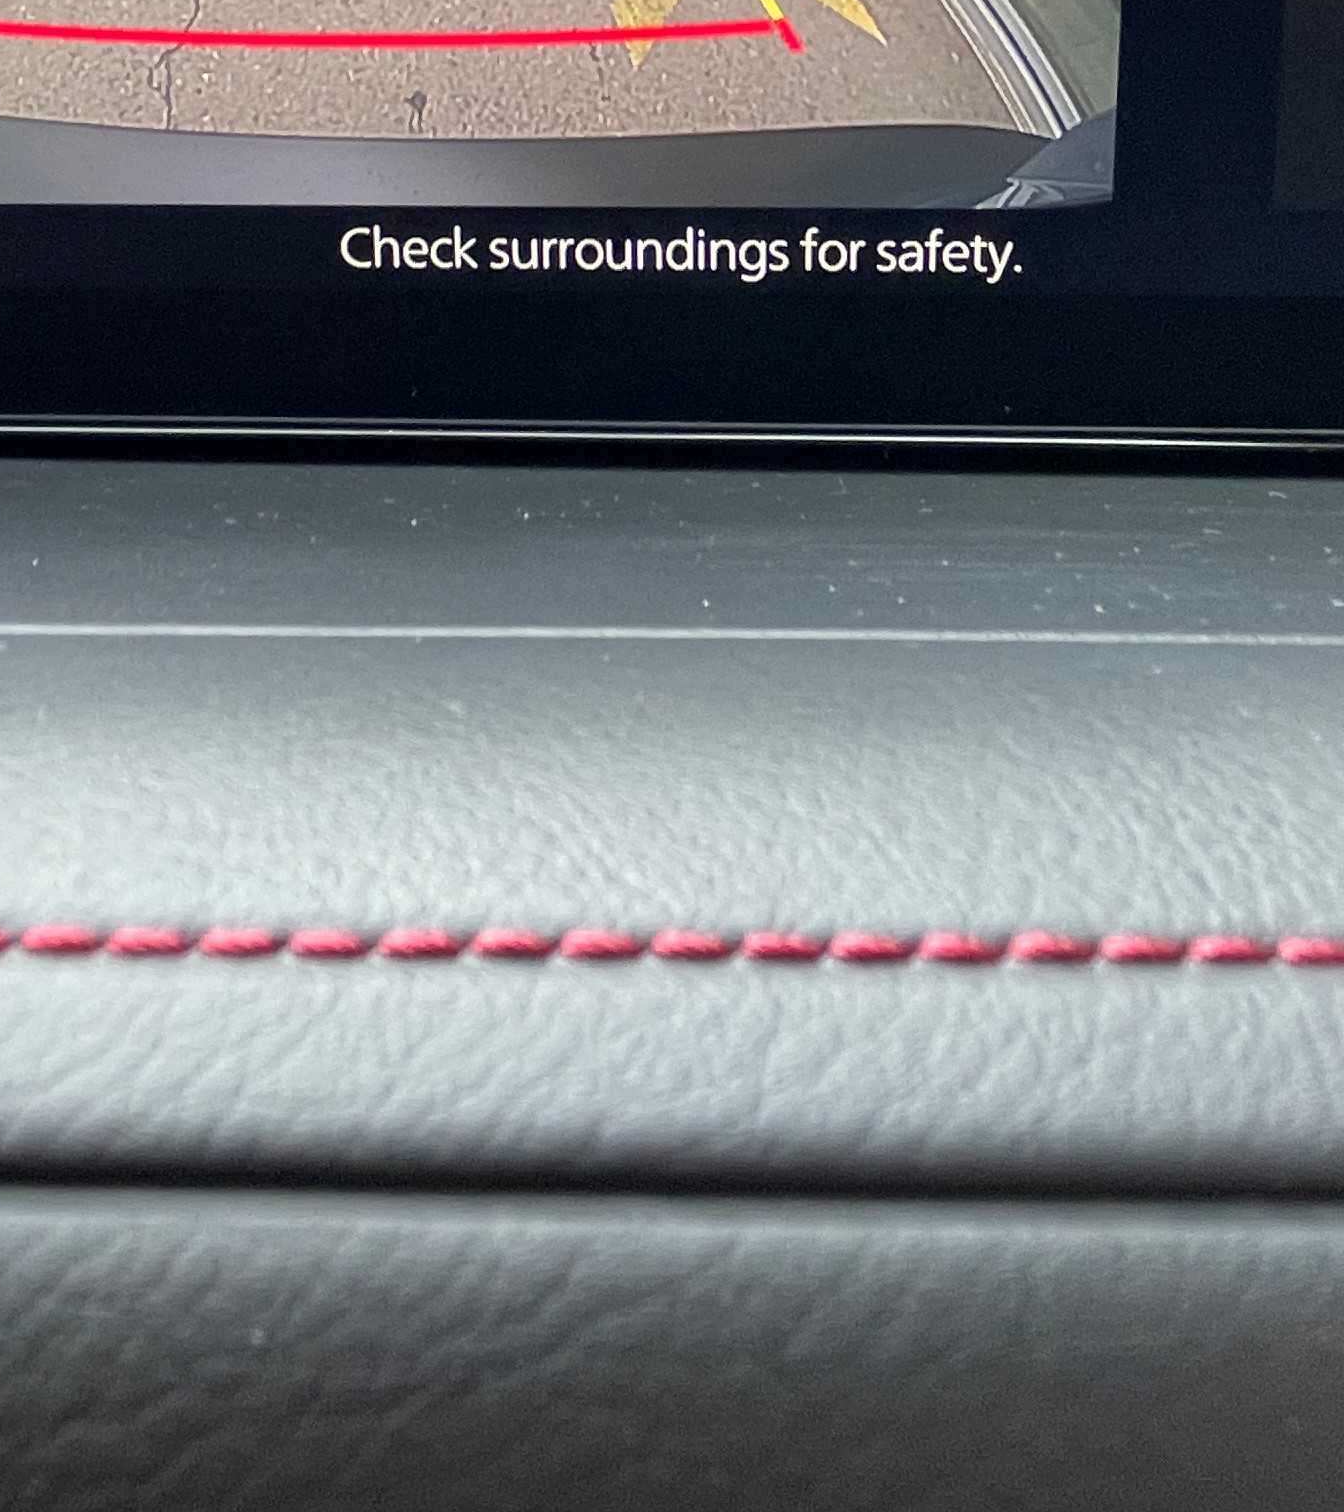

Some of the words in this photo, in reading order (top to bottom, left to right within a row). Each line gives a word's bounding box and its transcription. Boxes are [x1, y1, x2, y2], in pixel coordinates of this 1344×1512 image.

[340, 224, 479, 270] Check
[488, 225, 790, 283] surroundings
[799, 226, 867, 272] for
[875, 227, 1023, 284] safety.
